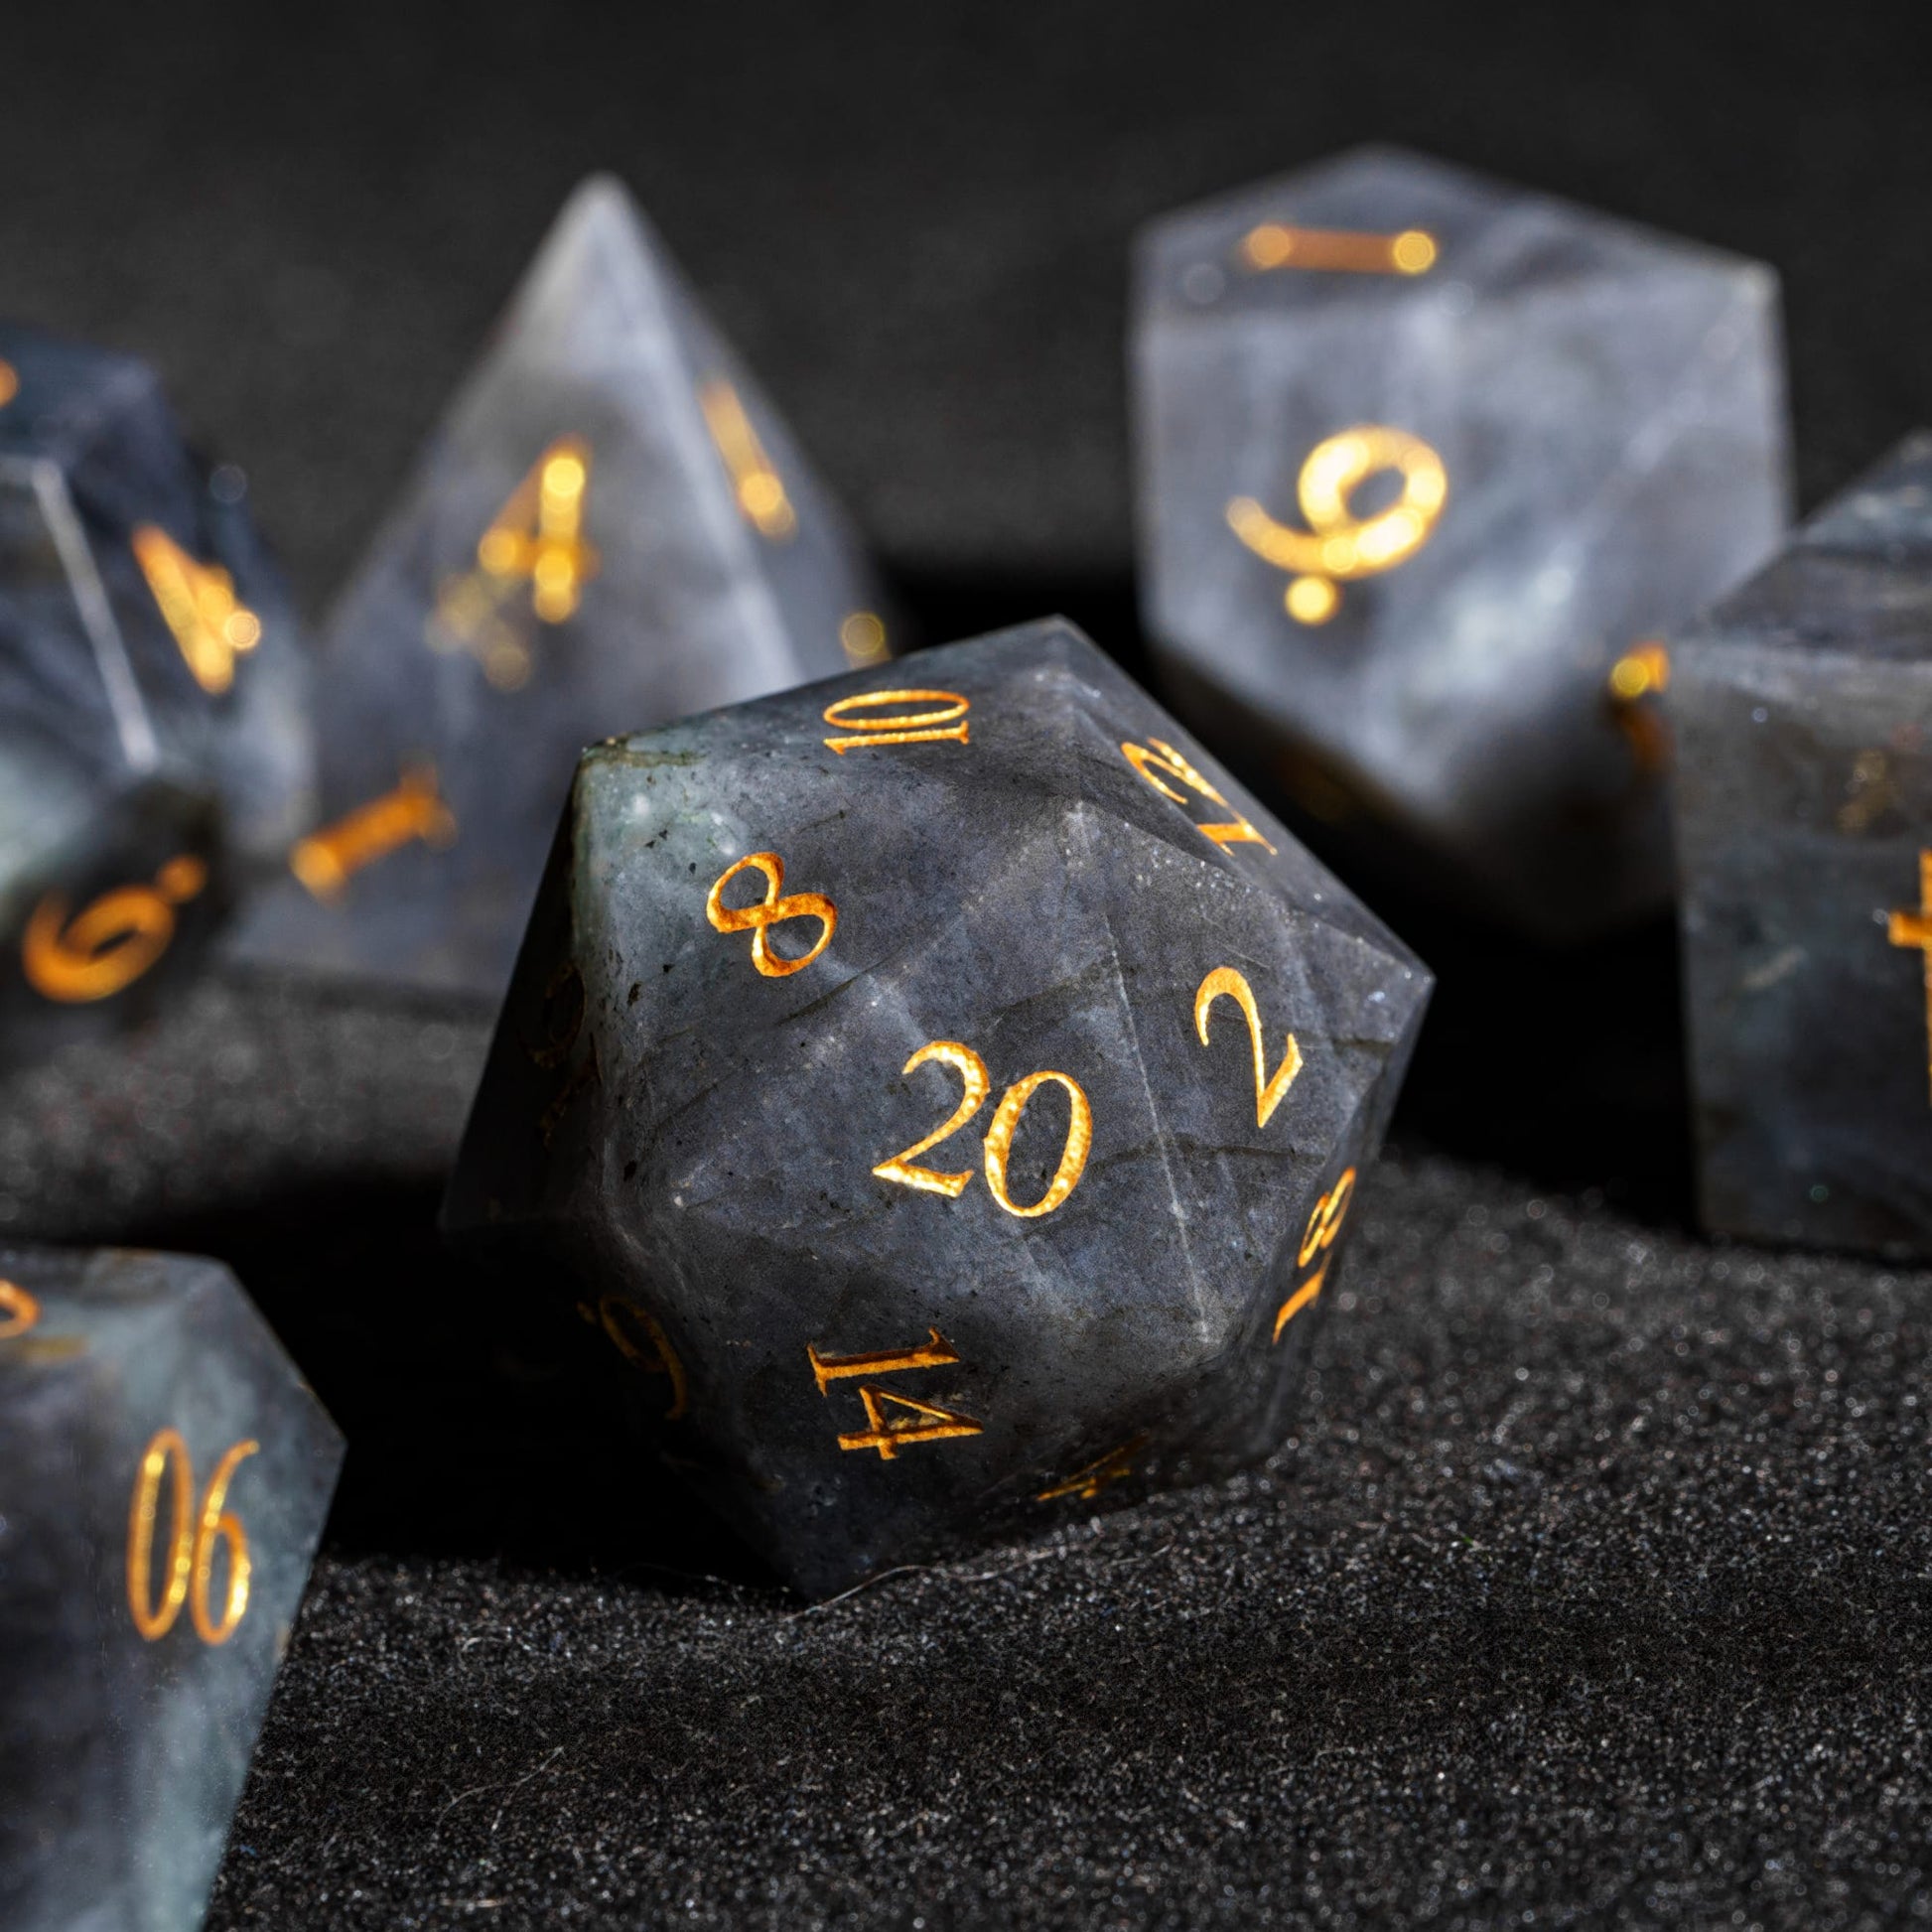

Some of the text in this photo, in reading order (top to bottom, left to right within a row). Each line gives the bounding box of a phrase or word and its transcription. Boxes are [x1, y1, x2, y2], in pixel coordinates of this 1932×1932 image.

[823, 689, 970, 755] 10
[1121, 737, 1278, 857] 12
[706, 851, 839, 979] 8
[1193, 966, 1304, 1129] 2
[872, 1039, 1094, 1219] 20
[1272, 1166, 1358, 1344] 18
[806, 1327, 984, 1461] 14
